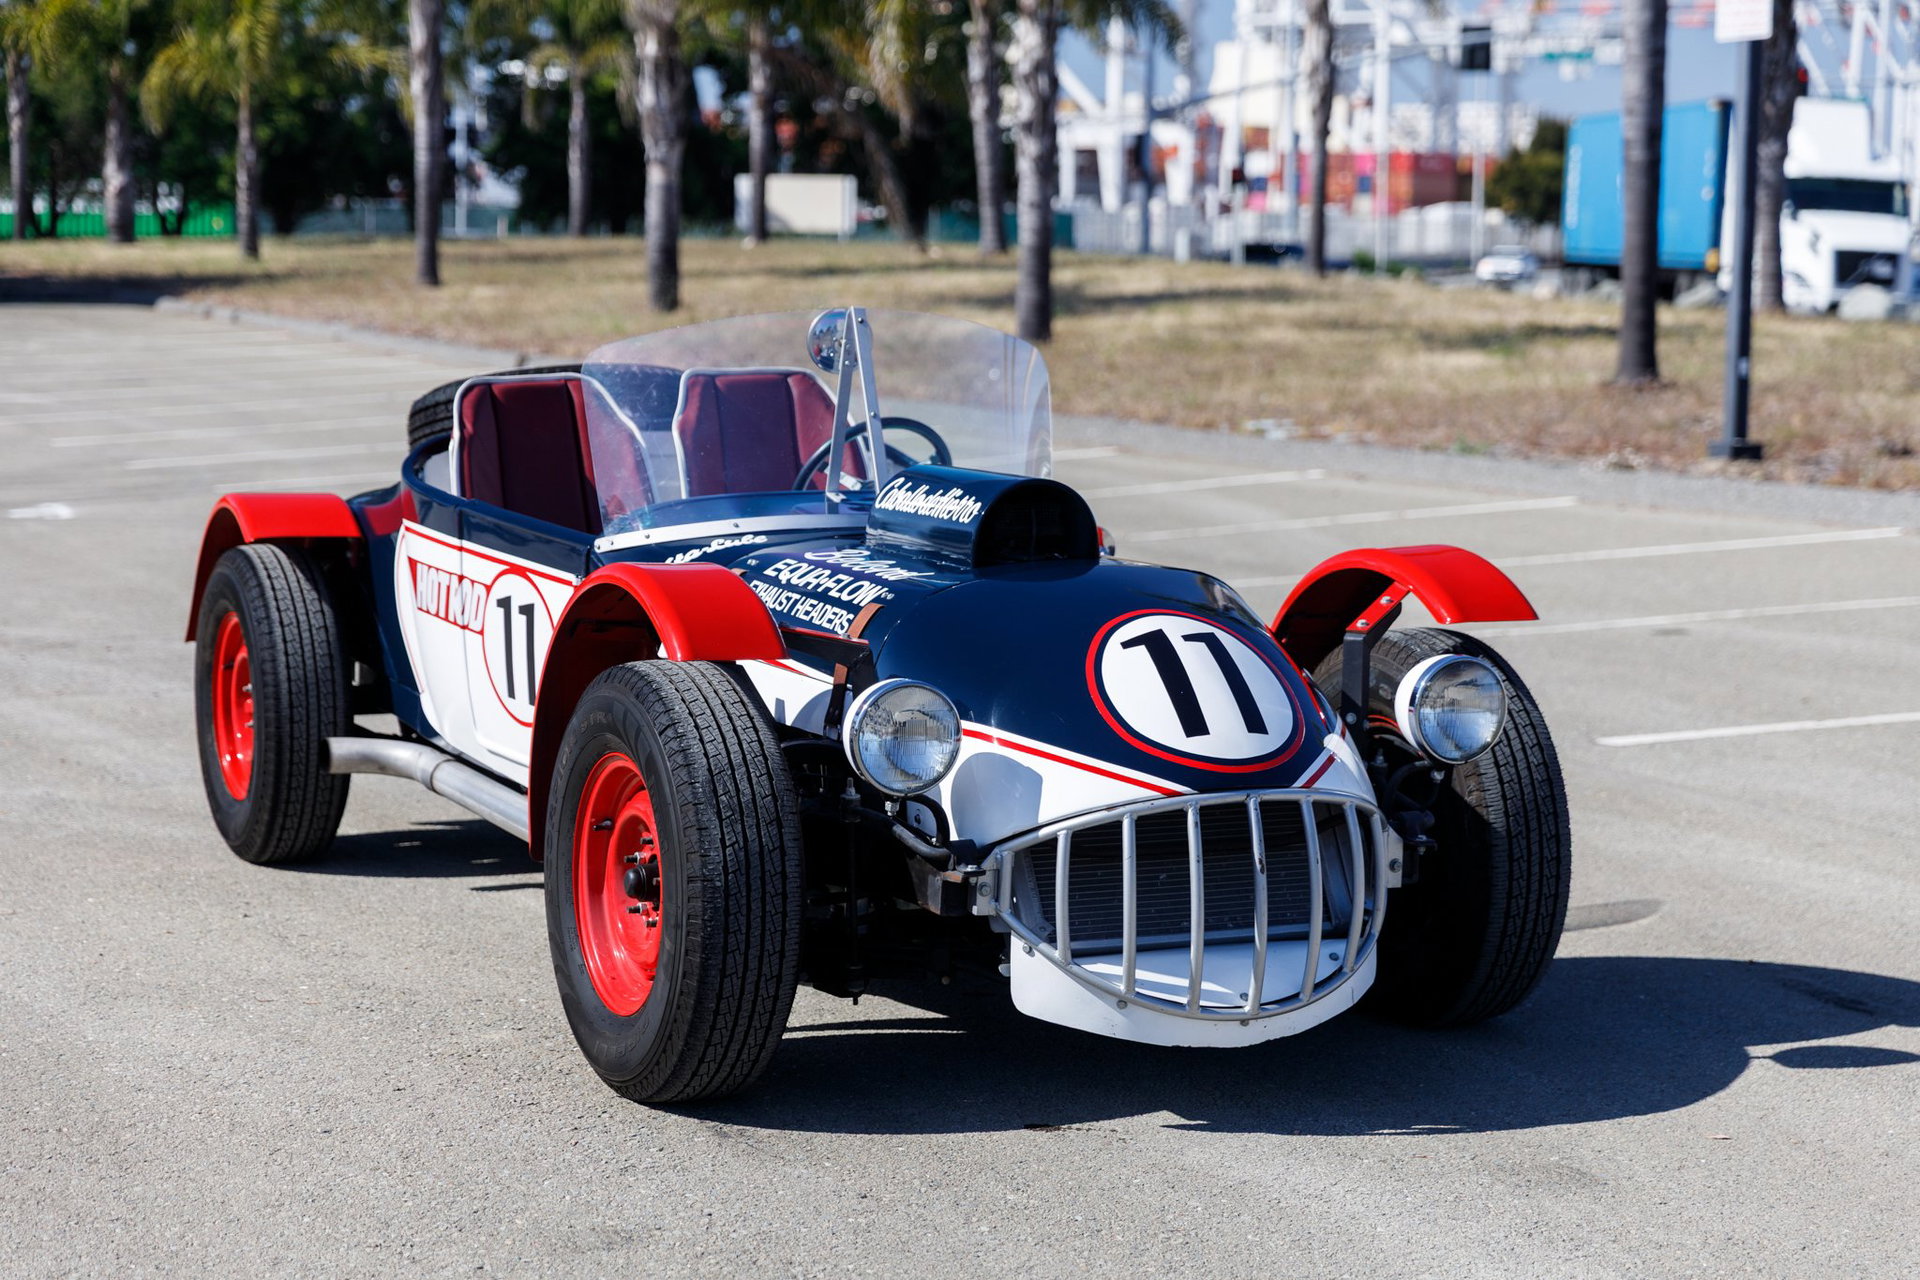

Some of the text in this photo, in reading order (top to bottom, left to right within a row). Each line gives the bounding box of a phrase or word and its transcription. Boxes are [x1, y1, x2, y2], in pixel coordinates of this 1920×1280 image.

[496, 595, 537, 707] 11
[791, 595, 855, 634] HEADERS
[1120, 628, 1269, 738] 11
